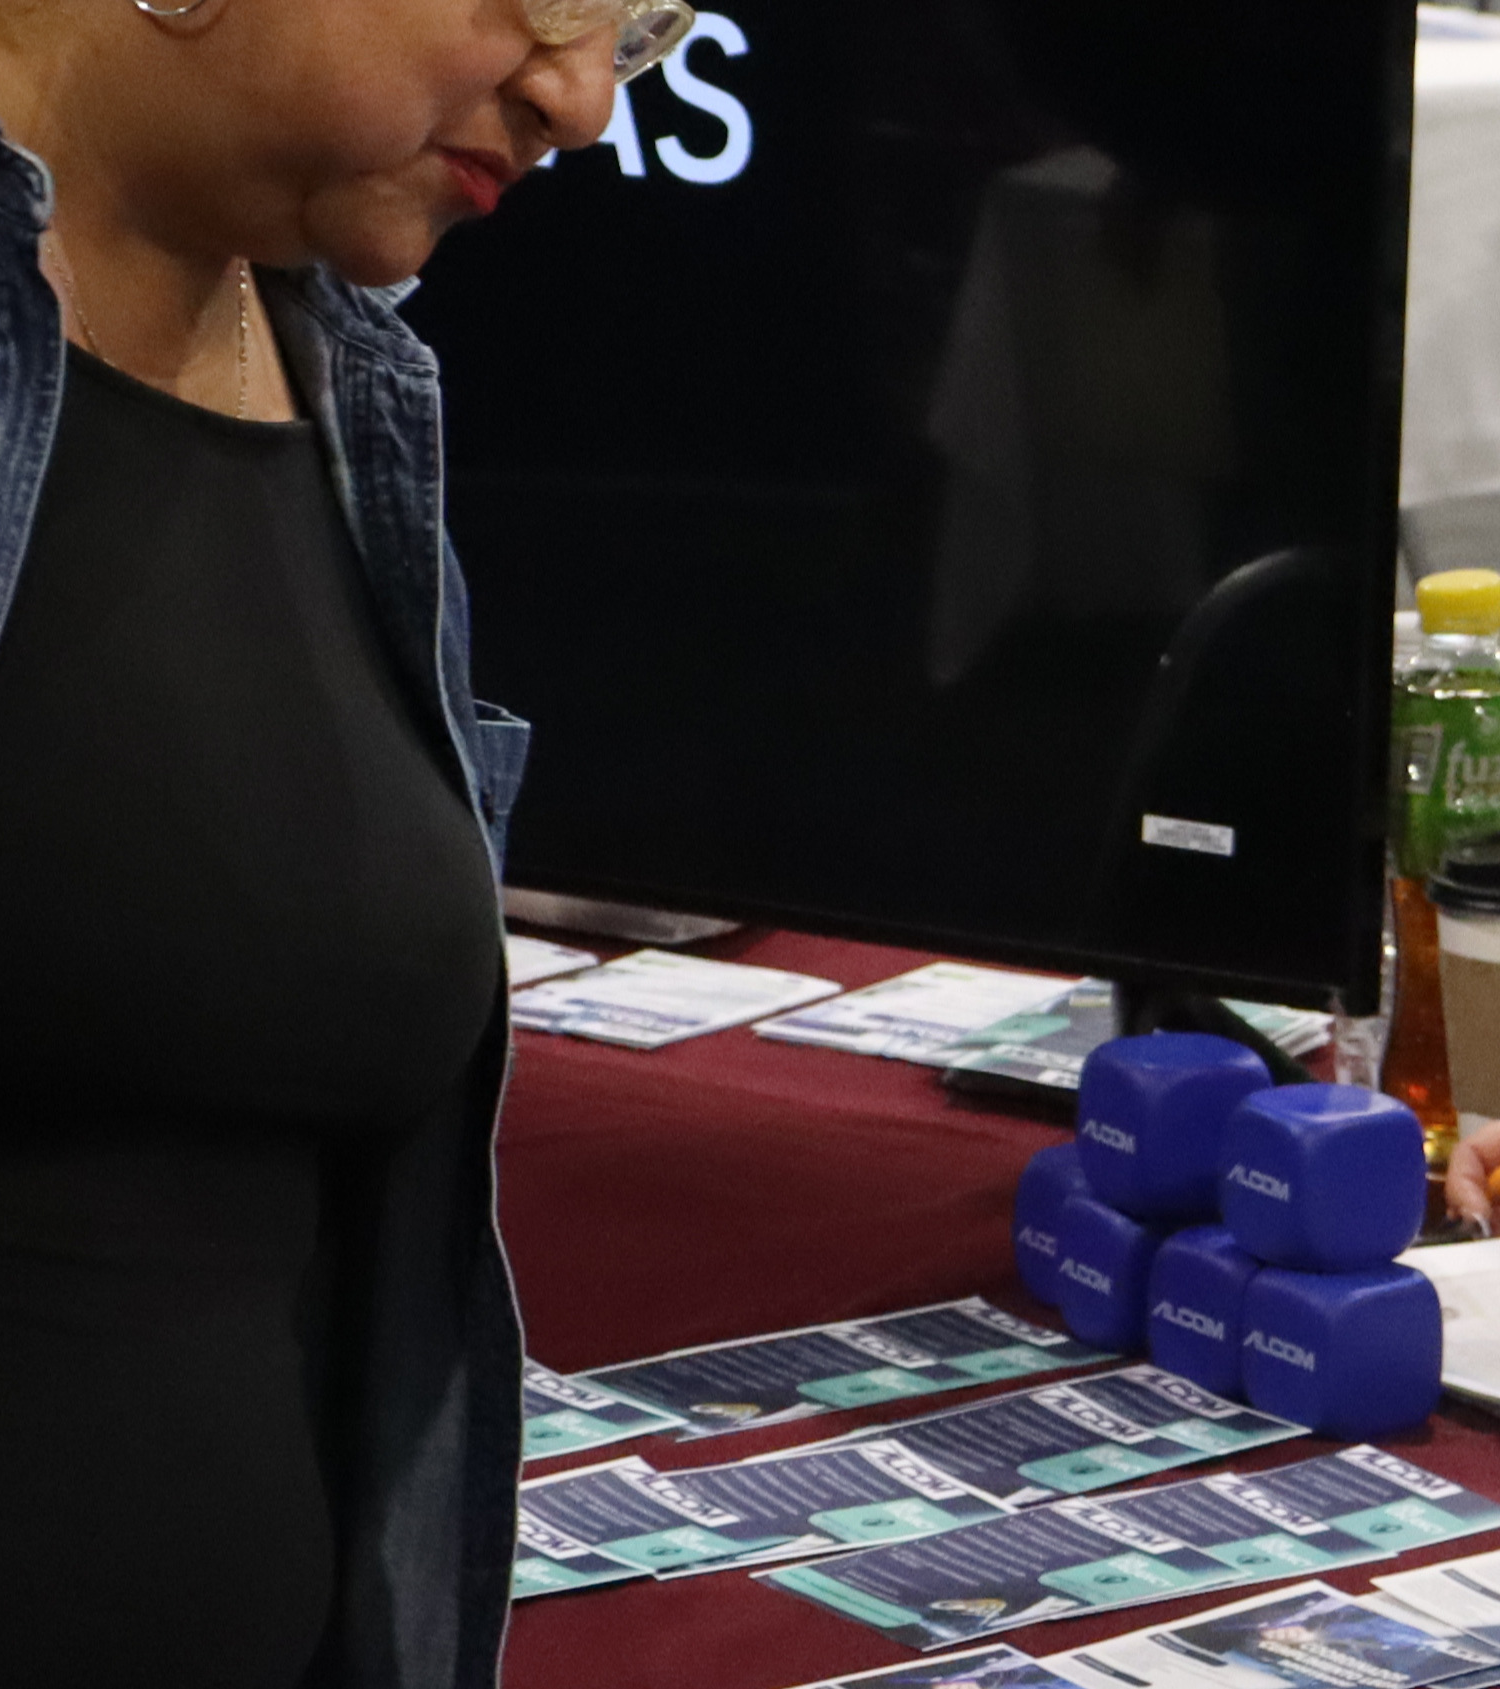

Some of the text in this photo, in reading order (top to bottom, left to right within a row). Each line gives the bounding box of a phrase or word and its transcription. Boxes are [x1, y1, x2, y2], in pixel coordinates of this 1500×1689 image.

[1081, 1118, 1137, 1155] ALCOM
[1227, 1163, 1291, 1203] ALCOM
[1059, 1257, 1113, 1296] ALCOM
[1152, 1300, 1225, 1342] ALCOM
[1243, 1330, 1317, 1372] ALCOM
[1345, 1449, 1450, 1493] ALCOM
